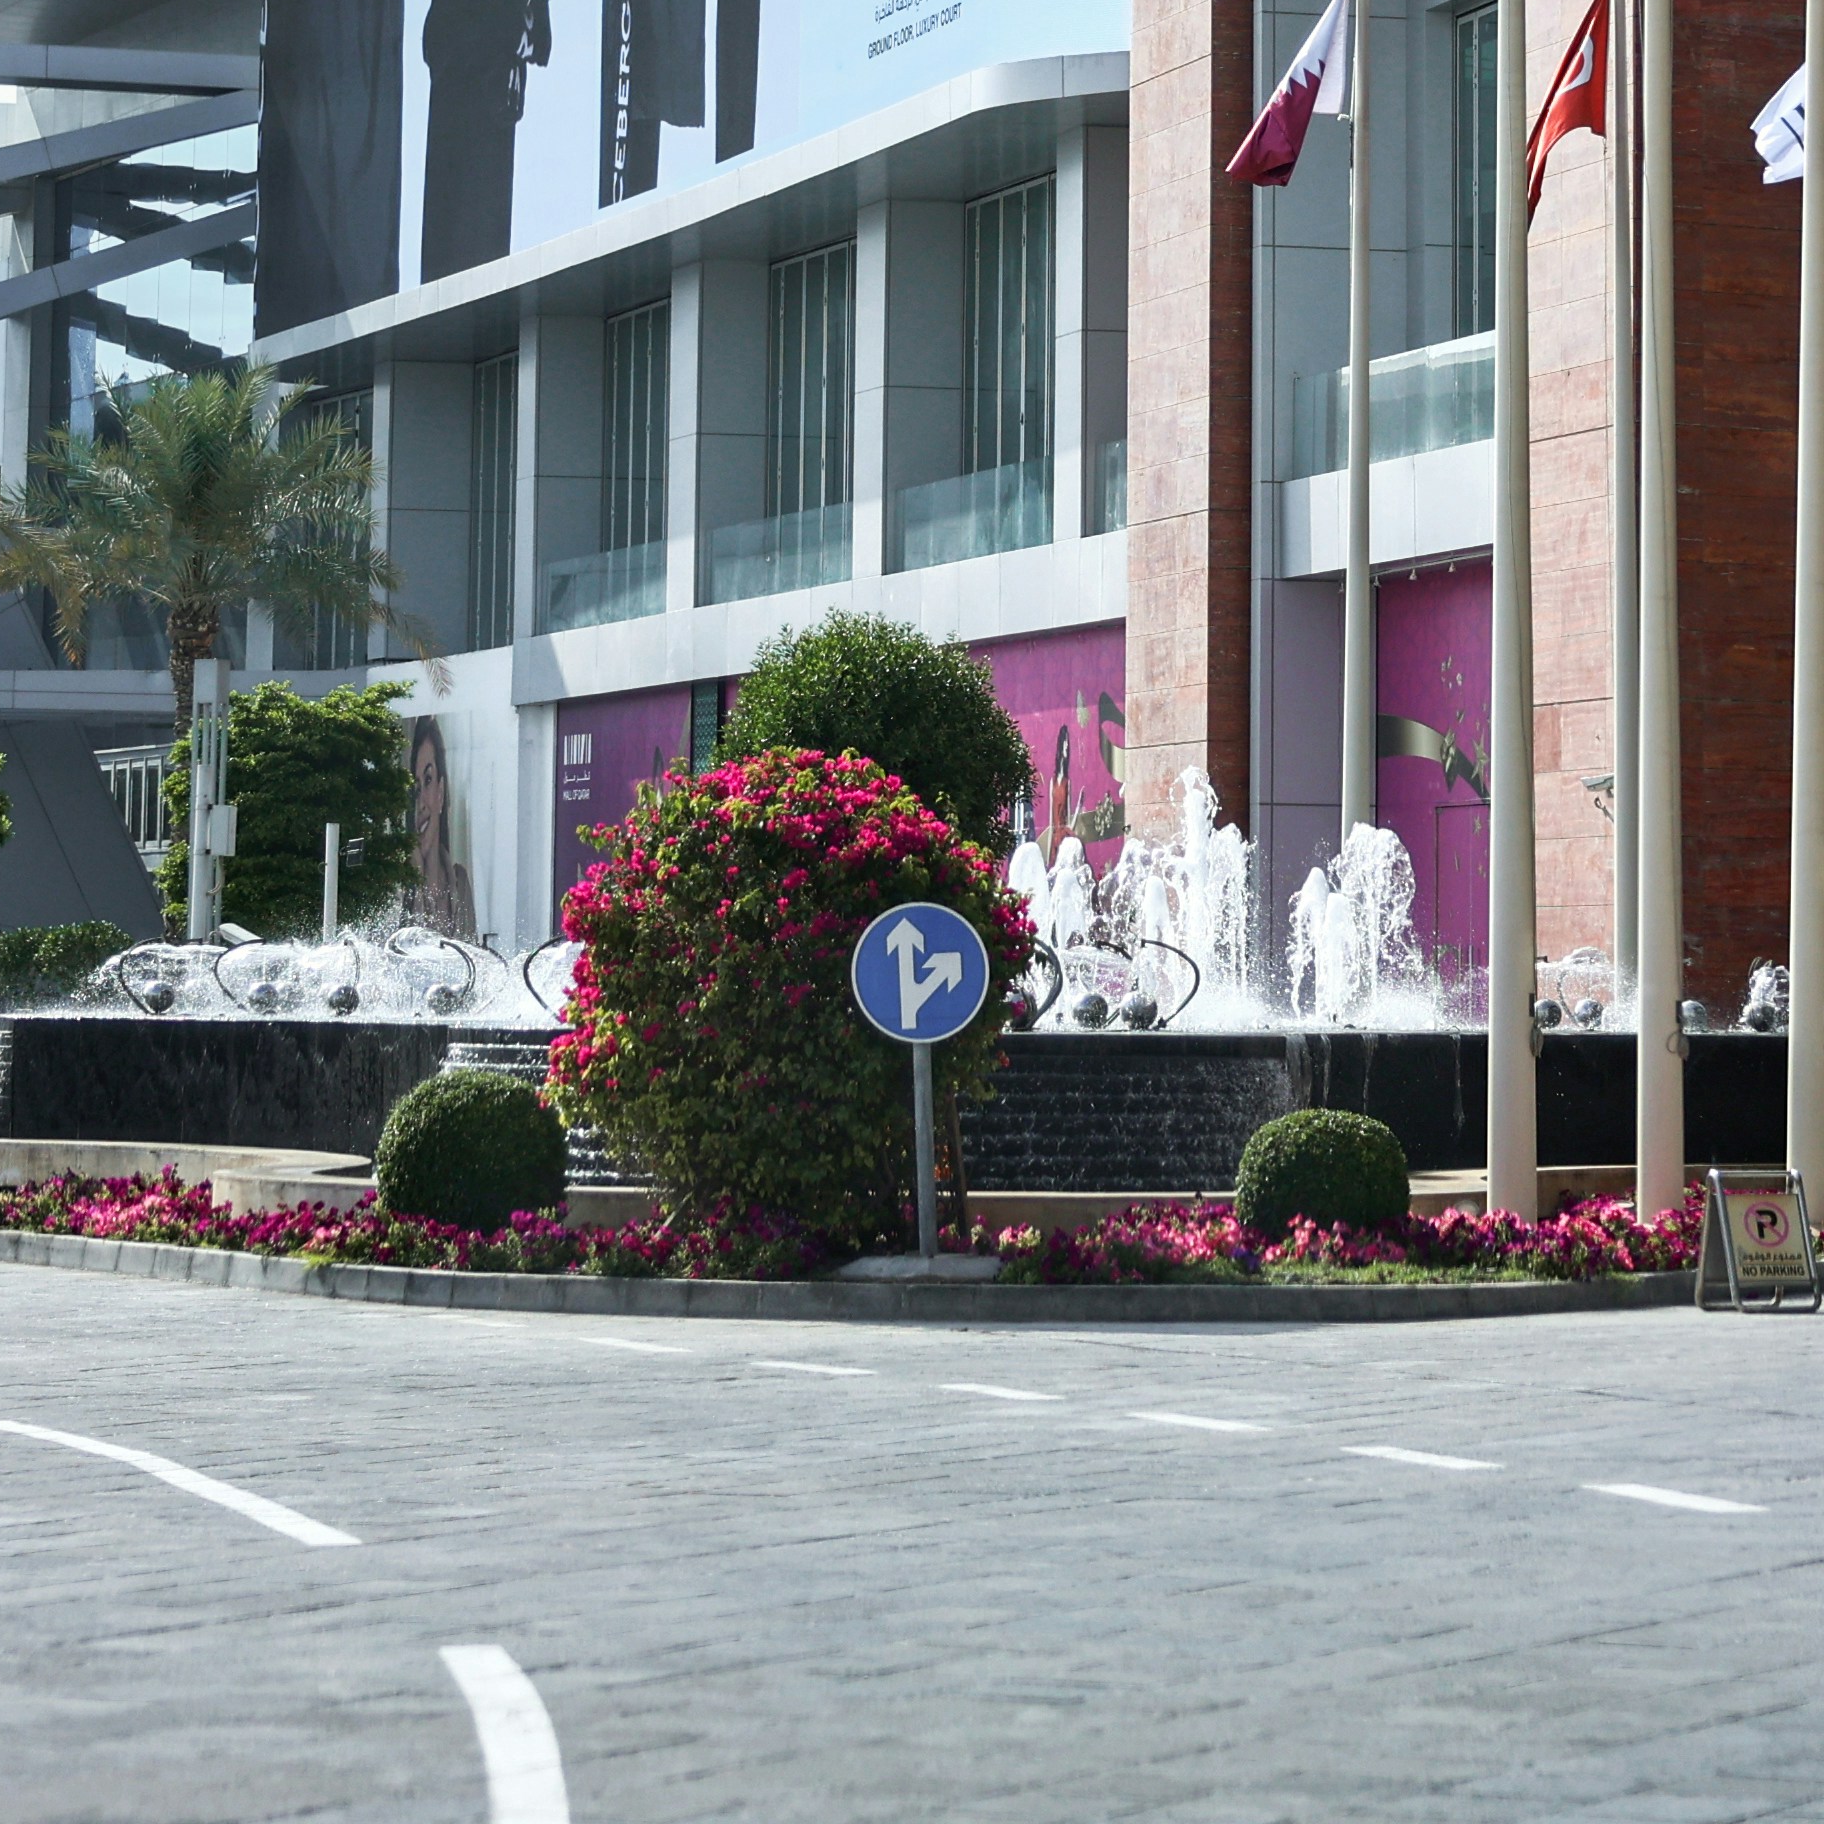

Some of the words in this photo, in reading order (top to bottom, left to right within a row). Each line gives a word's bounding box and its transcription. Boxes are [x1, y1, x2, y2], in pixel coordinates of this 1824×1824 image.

[868, 34, 893, 59] GROUND
[916, 12, 940, 38] LUXURY
[941, 2, 962, 26] COURT
[1743, 1266, 1757, 1276] NO
[1760, 1266, 1805, 1276] PARKING
